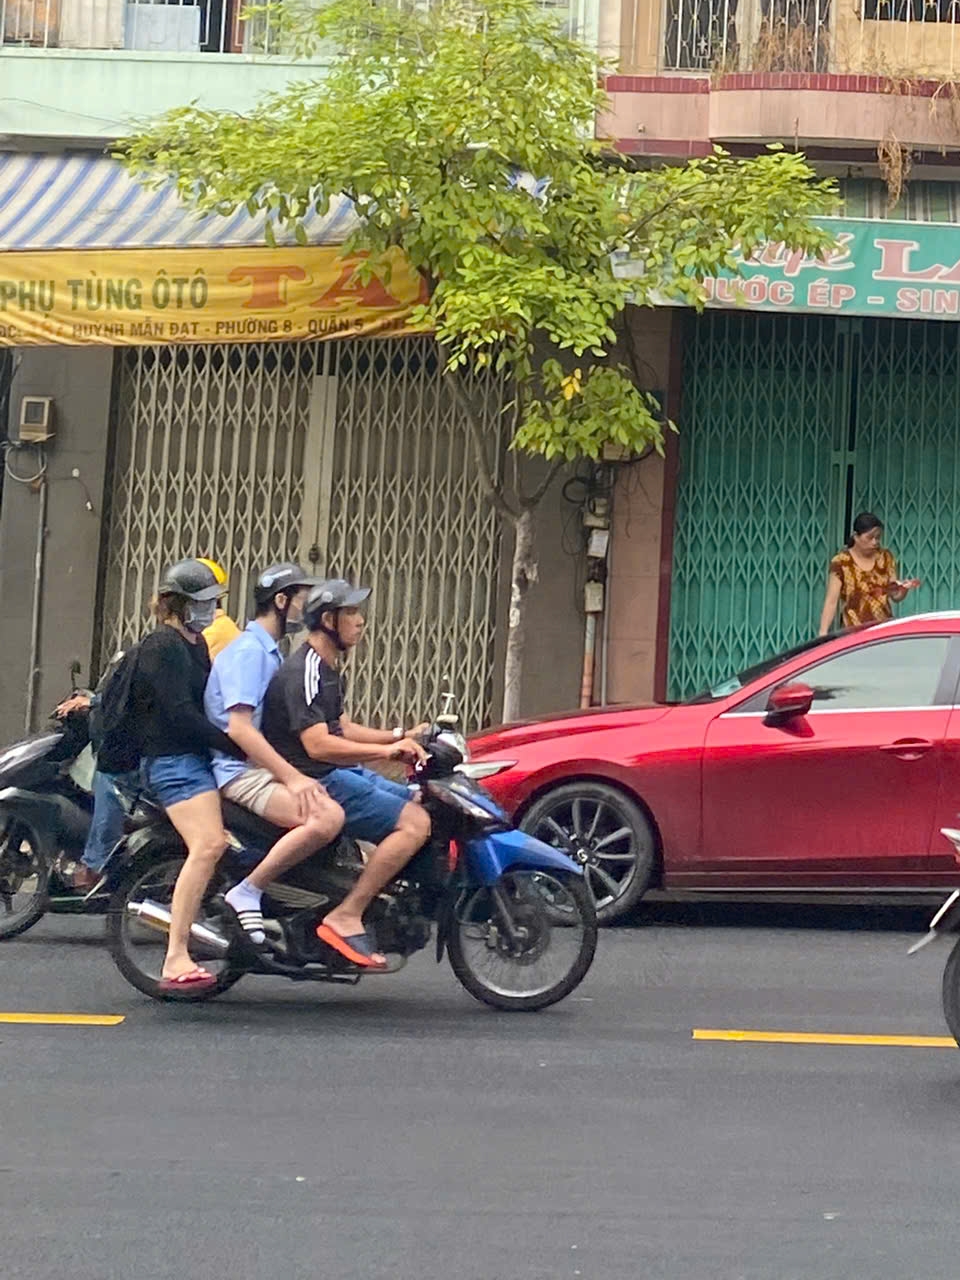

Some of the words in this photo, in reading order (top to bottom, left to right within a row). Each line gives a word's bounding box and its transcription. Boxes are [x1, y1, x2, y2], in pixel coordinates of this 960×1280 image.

[0, 279, 56, 318] PHỤ
[66, 270, 143, 311] TÙNG
[151, 268, 209, 310] ÔTÔ
[807, 277, 856, 308] ÉP
[215, 317, 279, 335] PHƯỜNG
[282, 320, 293, 334] 8
